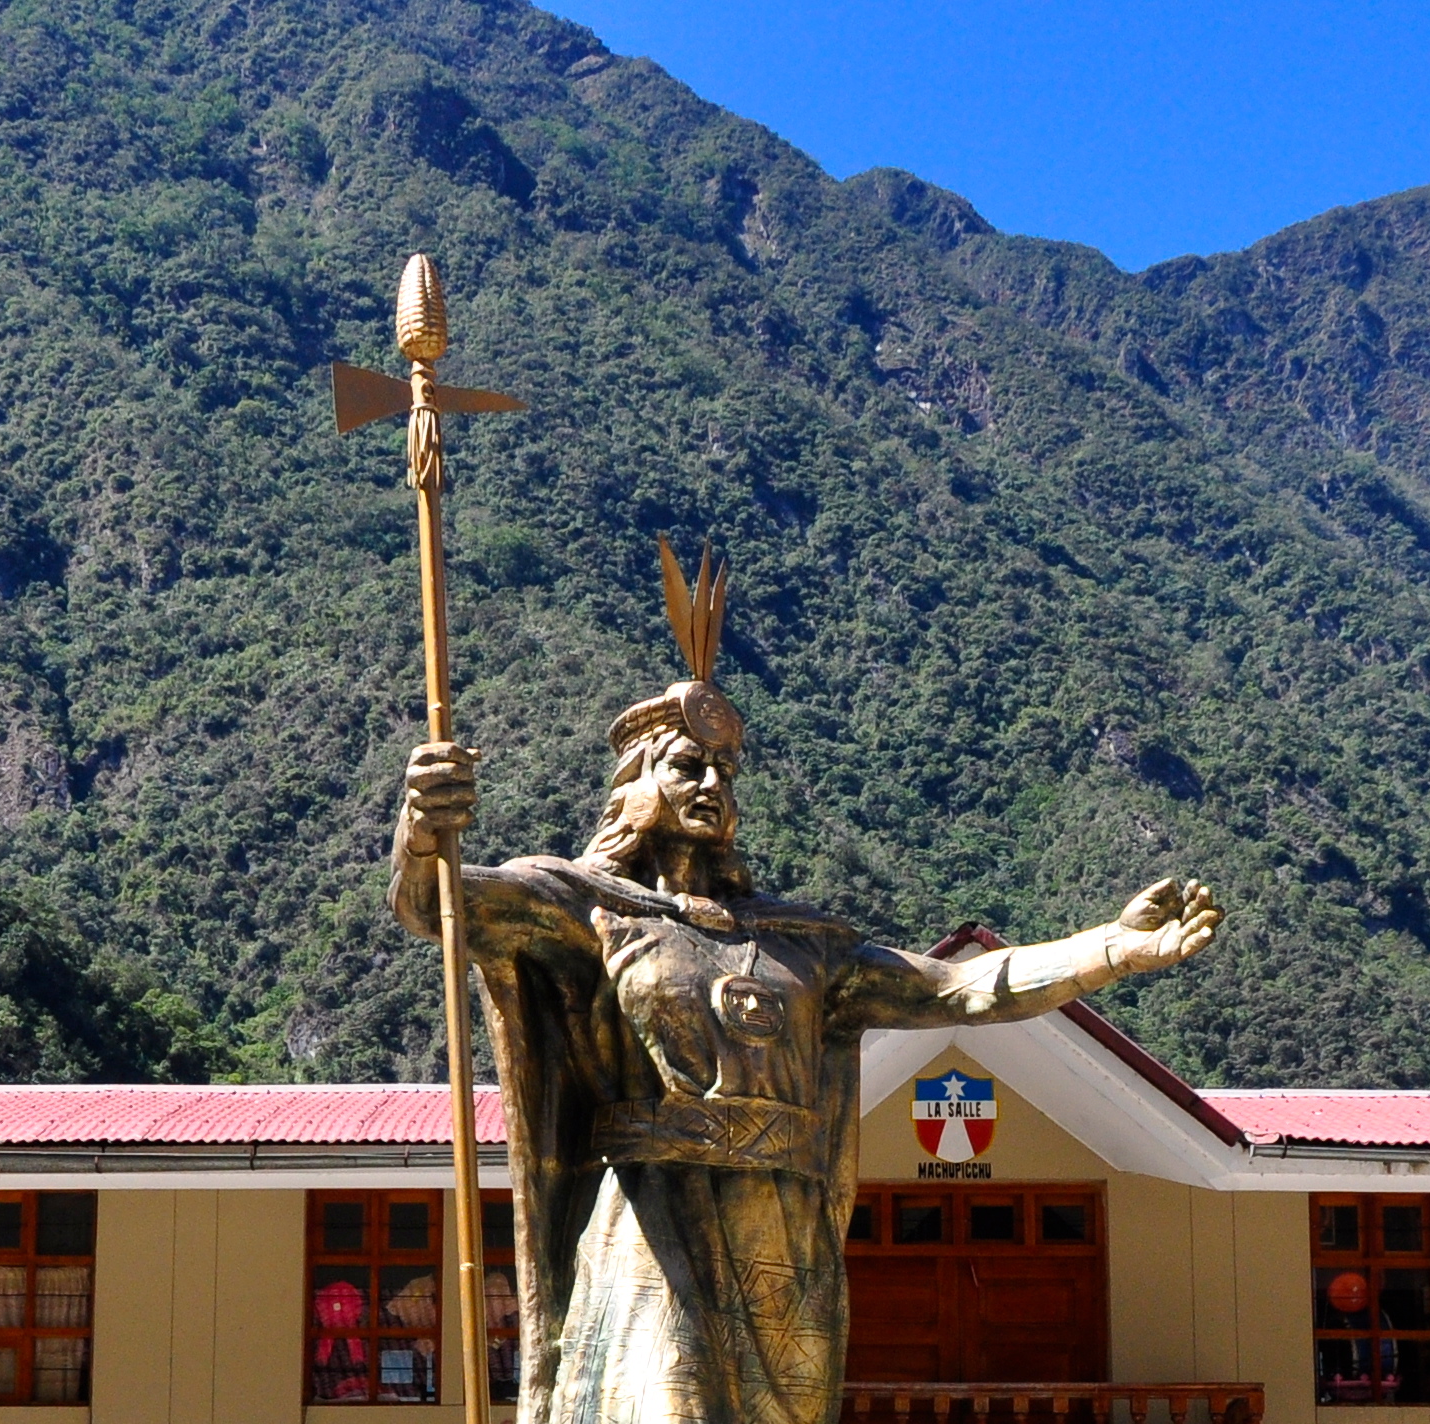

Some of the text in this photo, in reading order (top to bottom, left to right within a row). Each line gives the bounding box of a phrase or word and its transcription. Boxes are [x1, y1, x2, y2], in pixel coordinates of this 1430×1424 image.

[927, 1102, 982, 1118] LA SALLE
[918, 1162, 992, 1179] MACHUPICCHU
